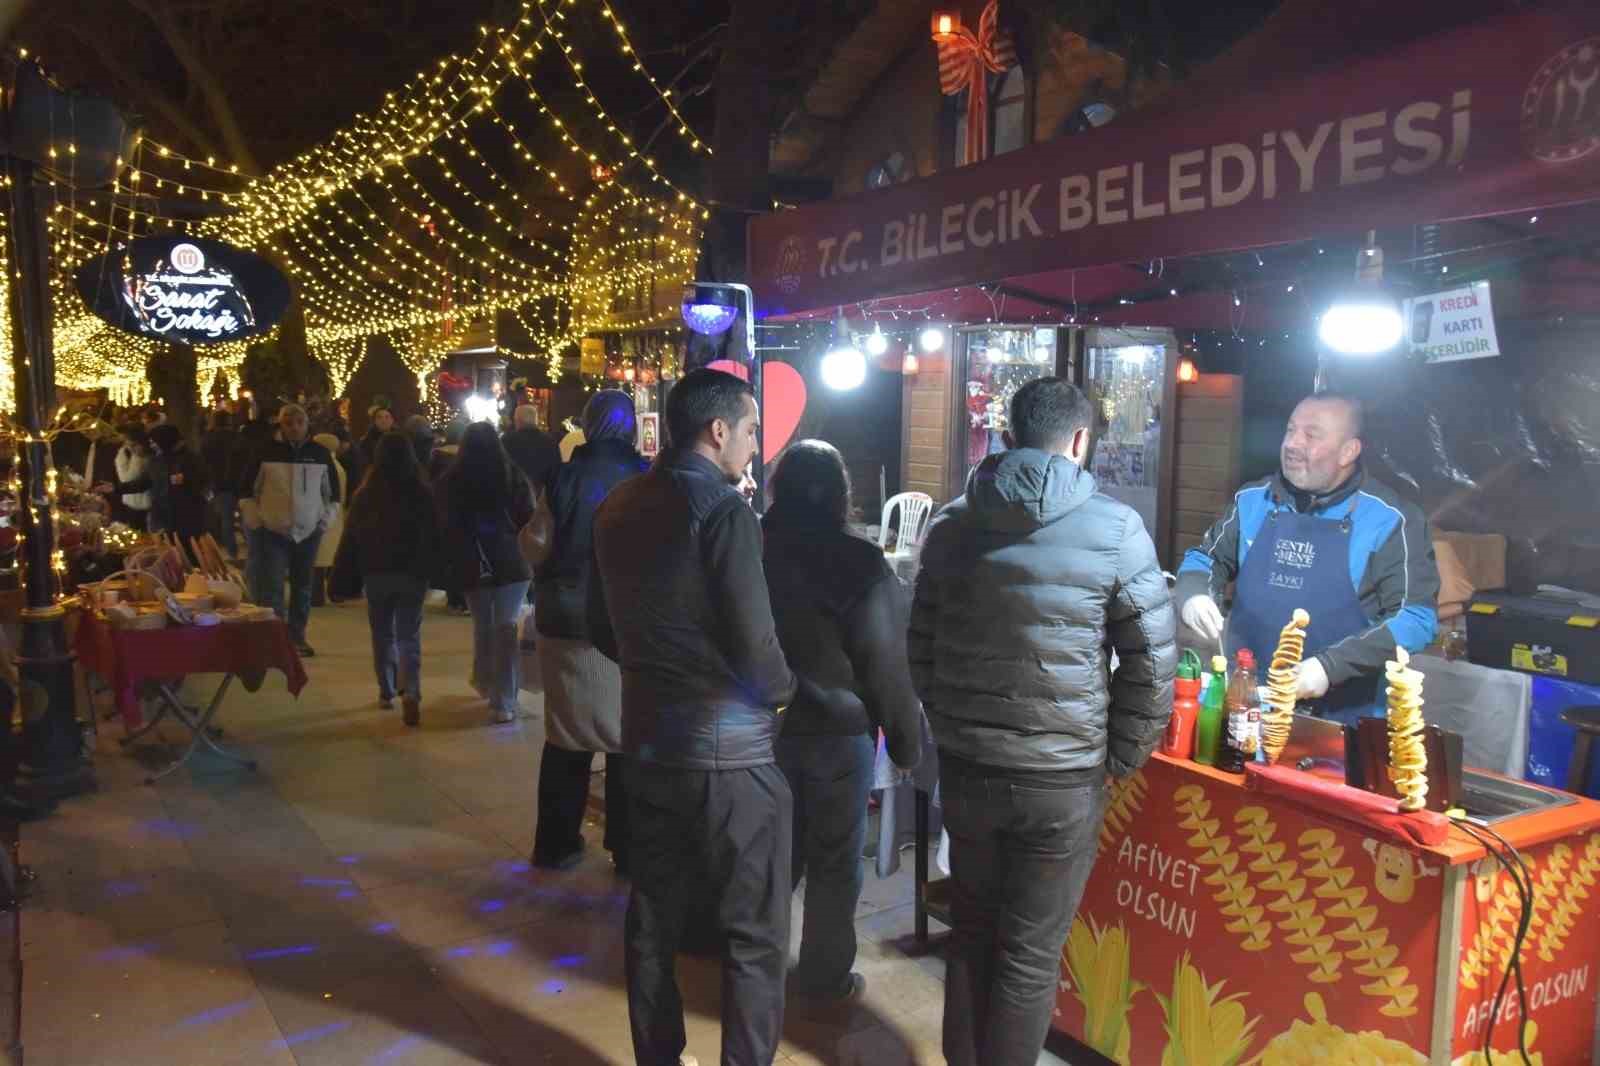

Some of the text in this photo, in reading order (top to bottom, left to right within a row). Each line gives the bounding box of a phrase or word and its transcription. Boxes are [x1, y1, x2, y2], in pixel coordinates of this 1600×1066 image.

[819, 90, 1471, 279] T.C. BİLECİK BELEDİYESİ
[1443, 317, 1483, 335] KARTI
[1118, 836, 1199, 896] AFİYET
[1118, 881, 1196, 938] OLSUN
[1531, 966, 1589, 1011] OLSUN
